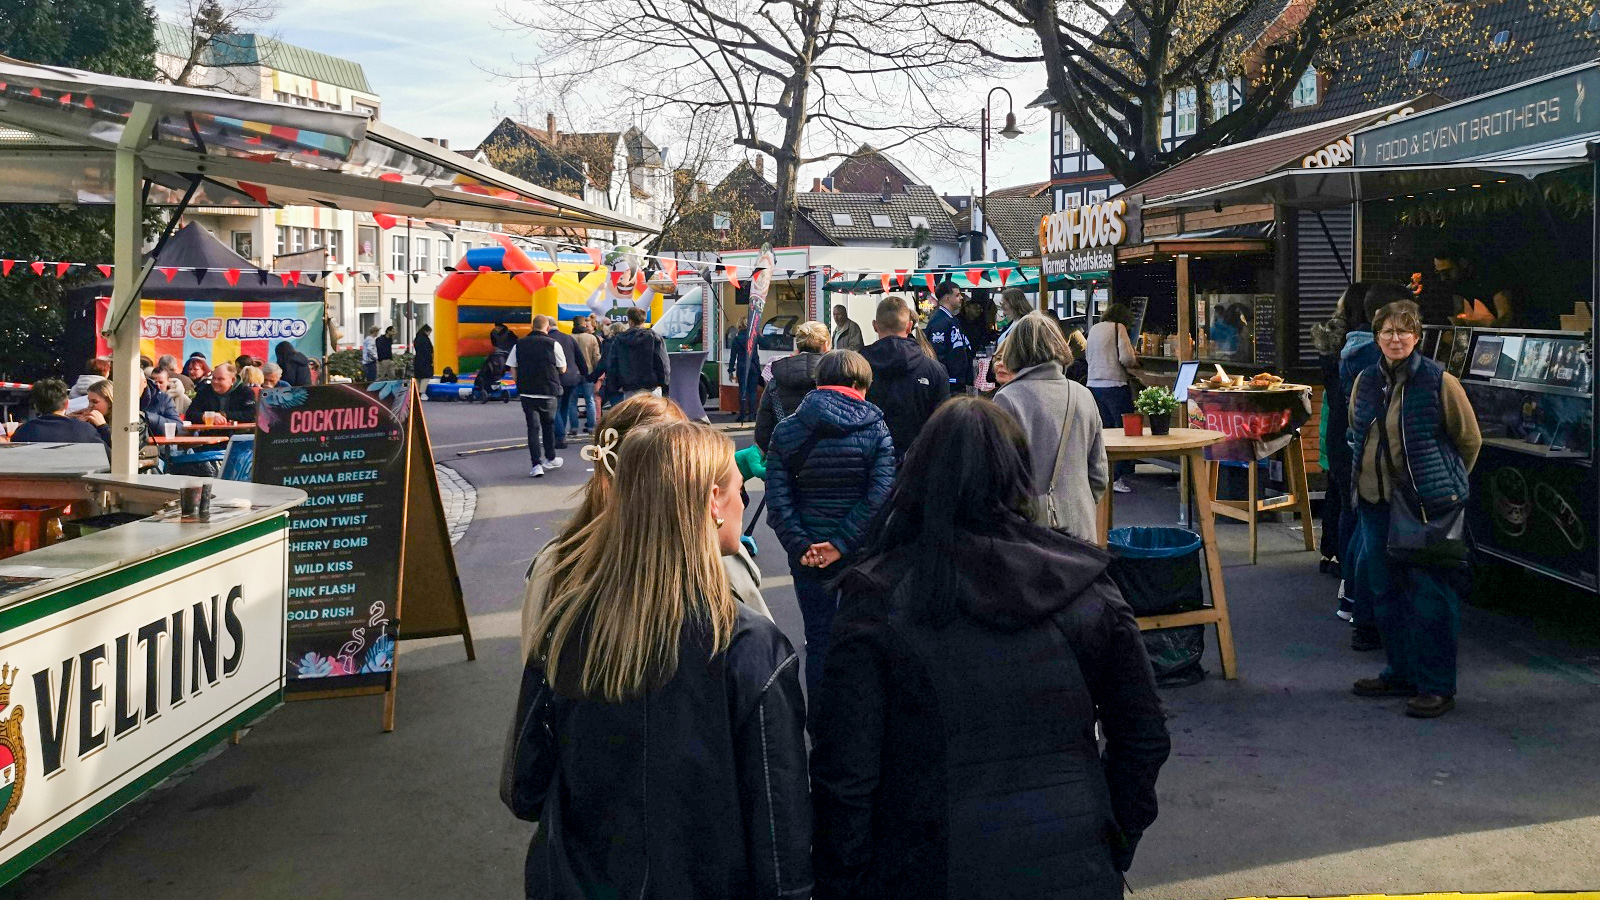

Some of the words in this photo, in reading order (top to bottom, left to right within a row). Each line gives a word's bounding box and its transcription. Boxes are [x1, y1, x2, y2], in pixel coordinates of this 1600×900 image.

[1376, 138, 1407, 163] FOOD
[1410, 134, 1420, 155] &
[1422, 121, 1467, 153] EVENT
[1470, 97, 1560, 141] BROTHERS
[1042, 255, 1068, 275] Warmer
[1069, 249, 1113, 272] Schafskäse
[140, 316, 187, 339] STE
[189, 317, 223, 339] OF
[225, 317, 308, 340] MEXICO
[290, 406, 379, 434] COCKTAILS
[300, 451, 339, 463] ALOHA
[343, 449, 366, 460] RED
[283, 473, 334, 486] HAVANA
[337, 470, 378, 482] BREEZE
[298, 495, 335, 507] ELON
[338, 493, 364, 504] VIBE
[288, 517, 328, 530] LEMON
[331, 514, 368, 527] TWIST
[333, 537, 368, 549] BOMB
[294, 563, 324, 575] WILD
[327, 561, 354, 572] KISS
[288, 586, 317, 598] PINK
[319, 583, 356, 596] FLASH
[287, 609, 319, 621] GOLD
[322, 606, 354, 619] RUSH
[32, 583, 245, 780] VELTINS
